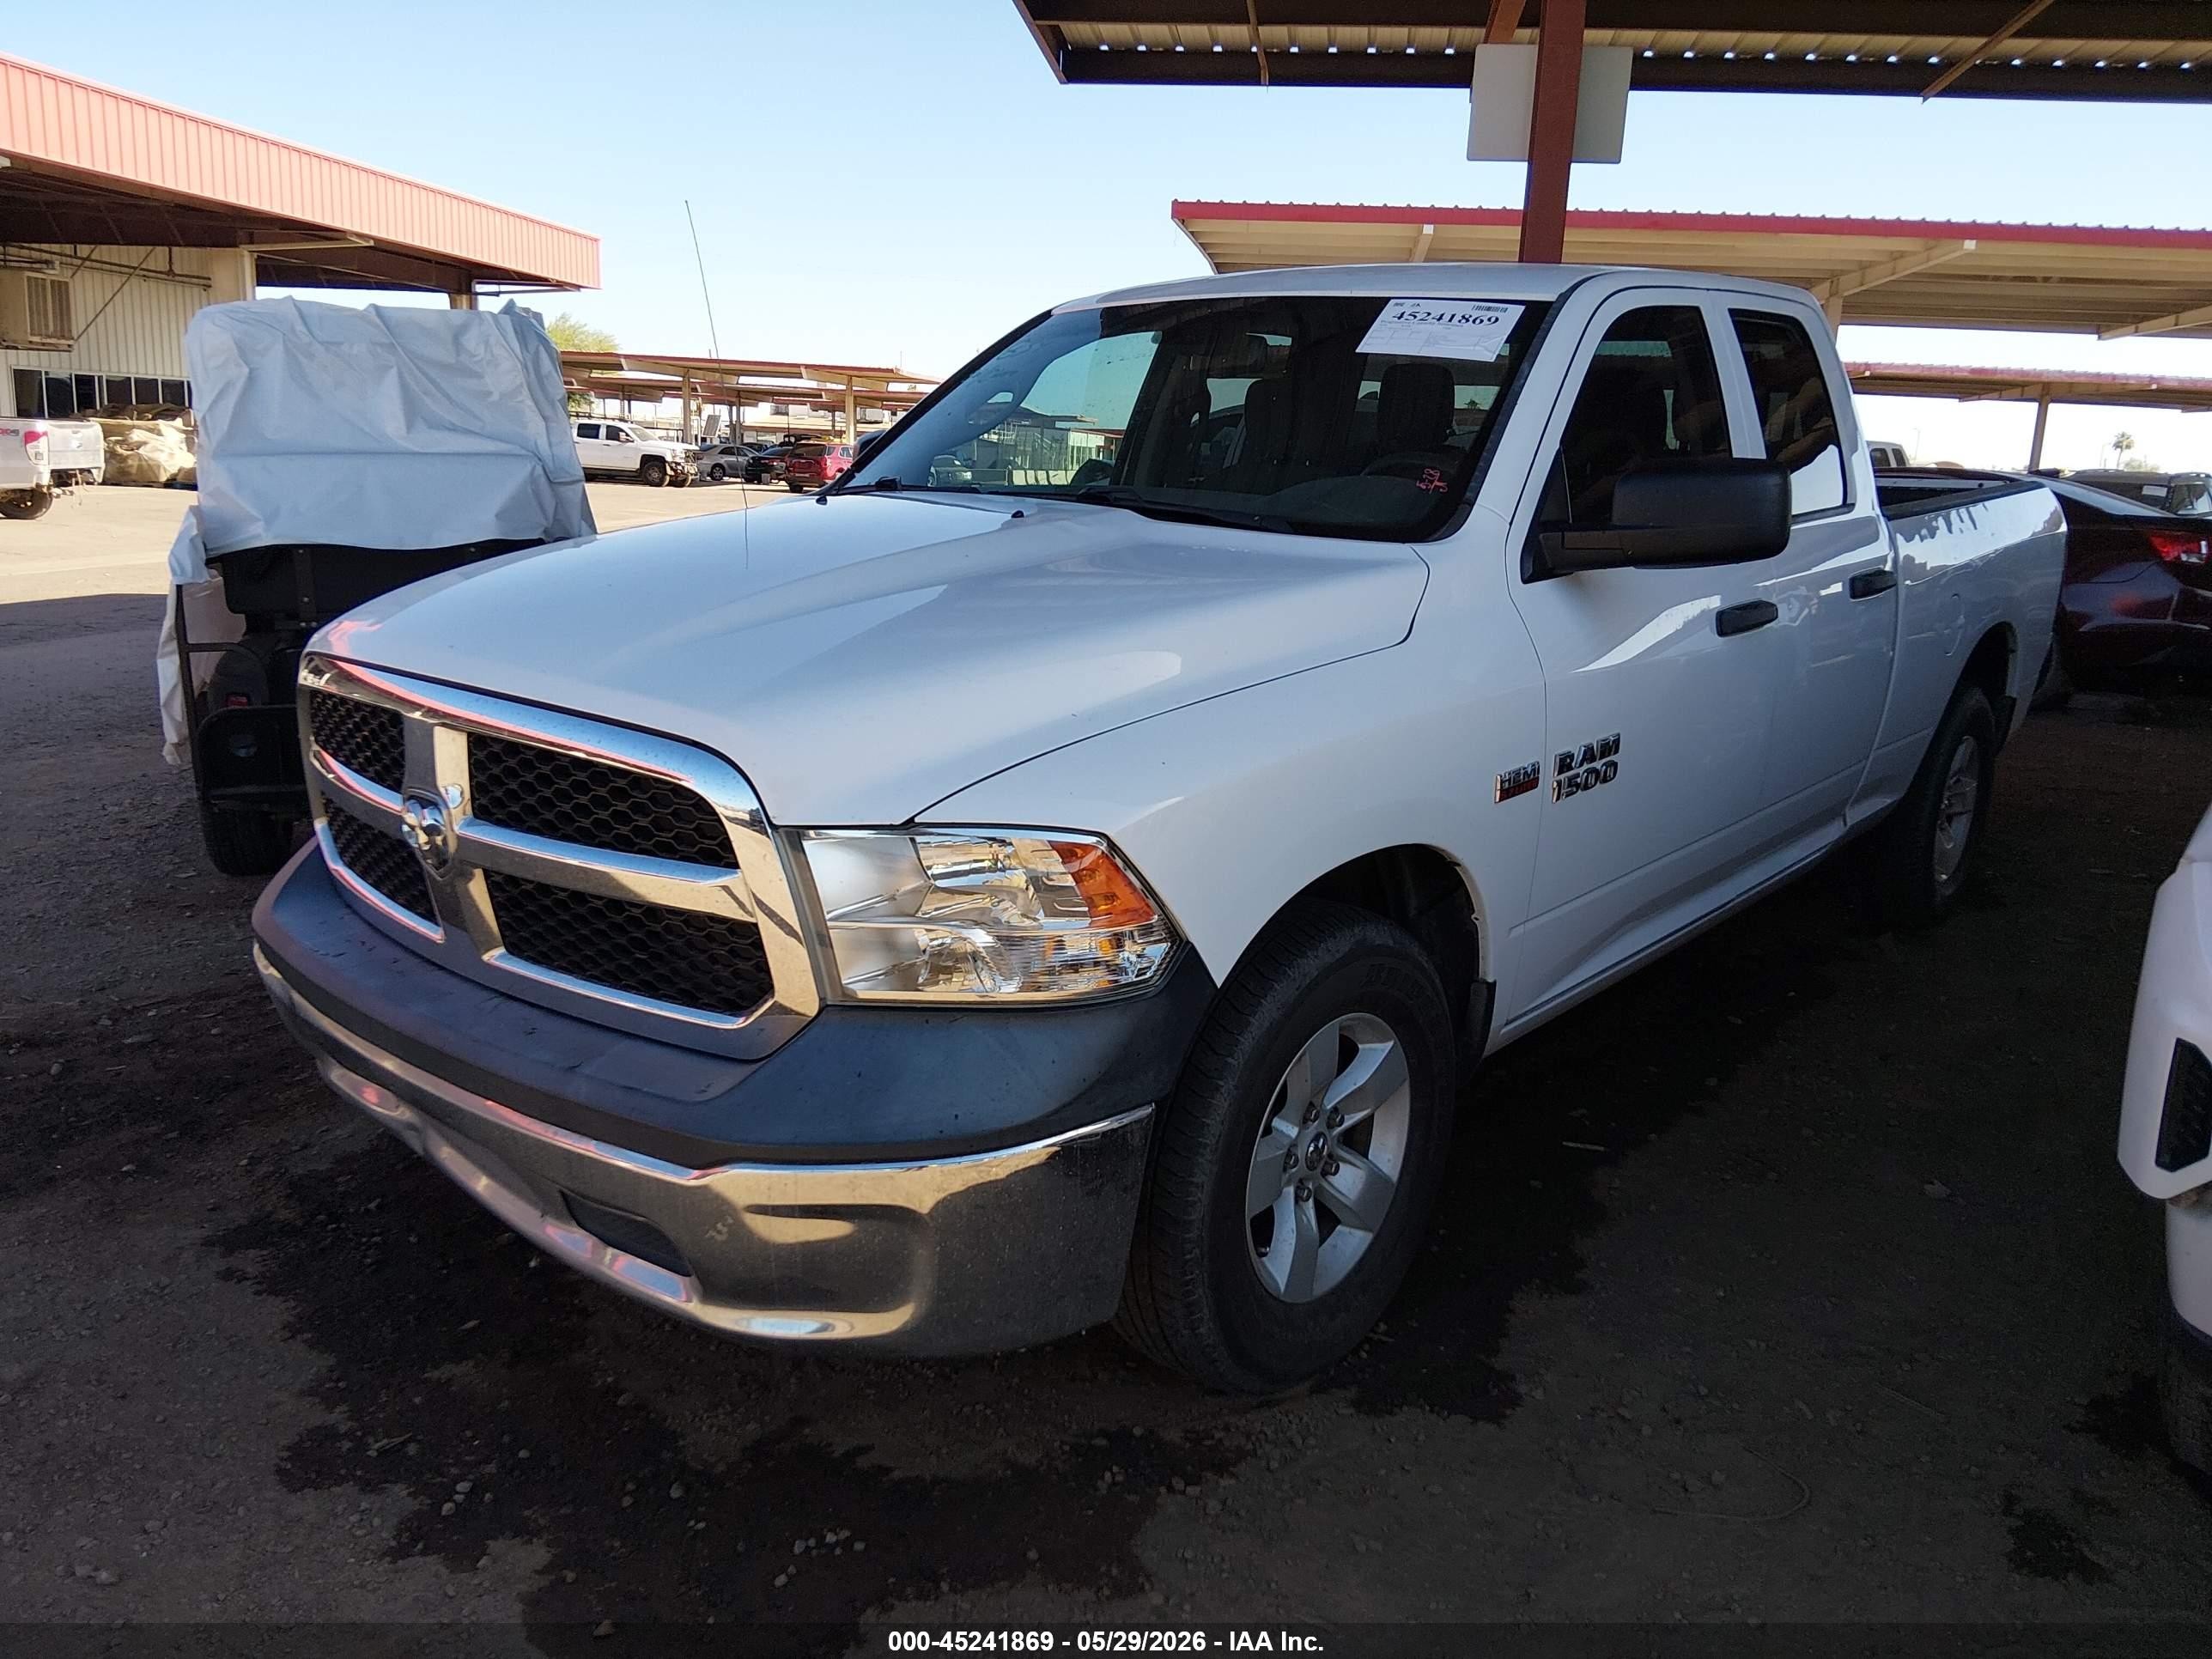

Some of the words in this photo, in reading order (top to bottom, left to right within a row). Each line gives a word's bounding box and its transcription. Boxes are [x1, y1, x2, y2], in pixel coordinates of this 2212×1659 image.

[1392, 311, 1499, 326] 45241869
[1553, 732, 1621, 777] RAM
[1500, 761, 1540, 790] HEMI
[1552, 759, 1619, 804] 1500
